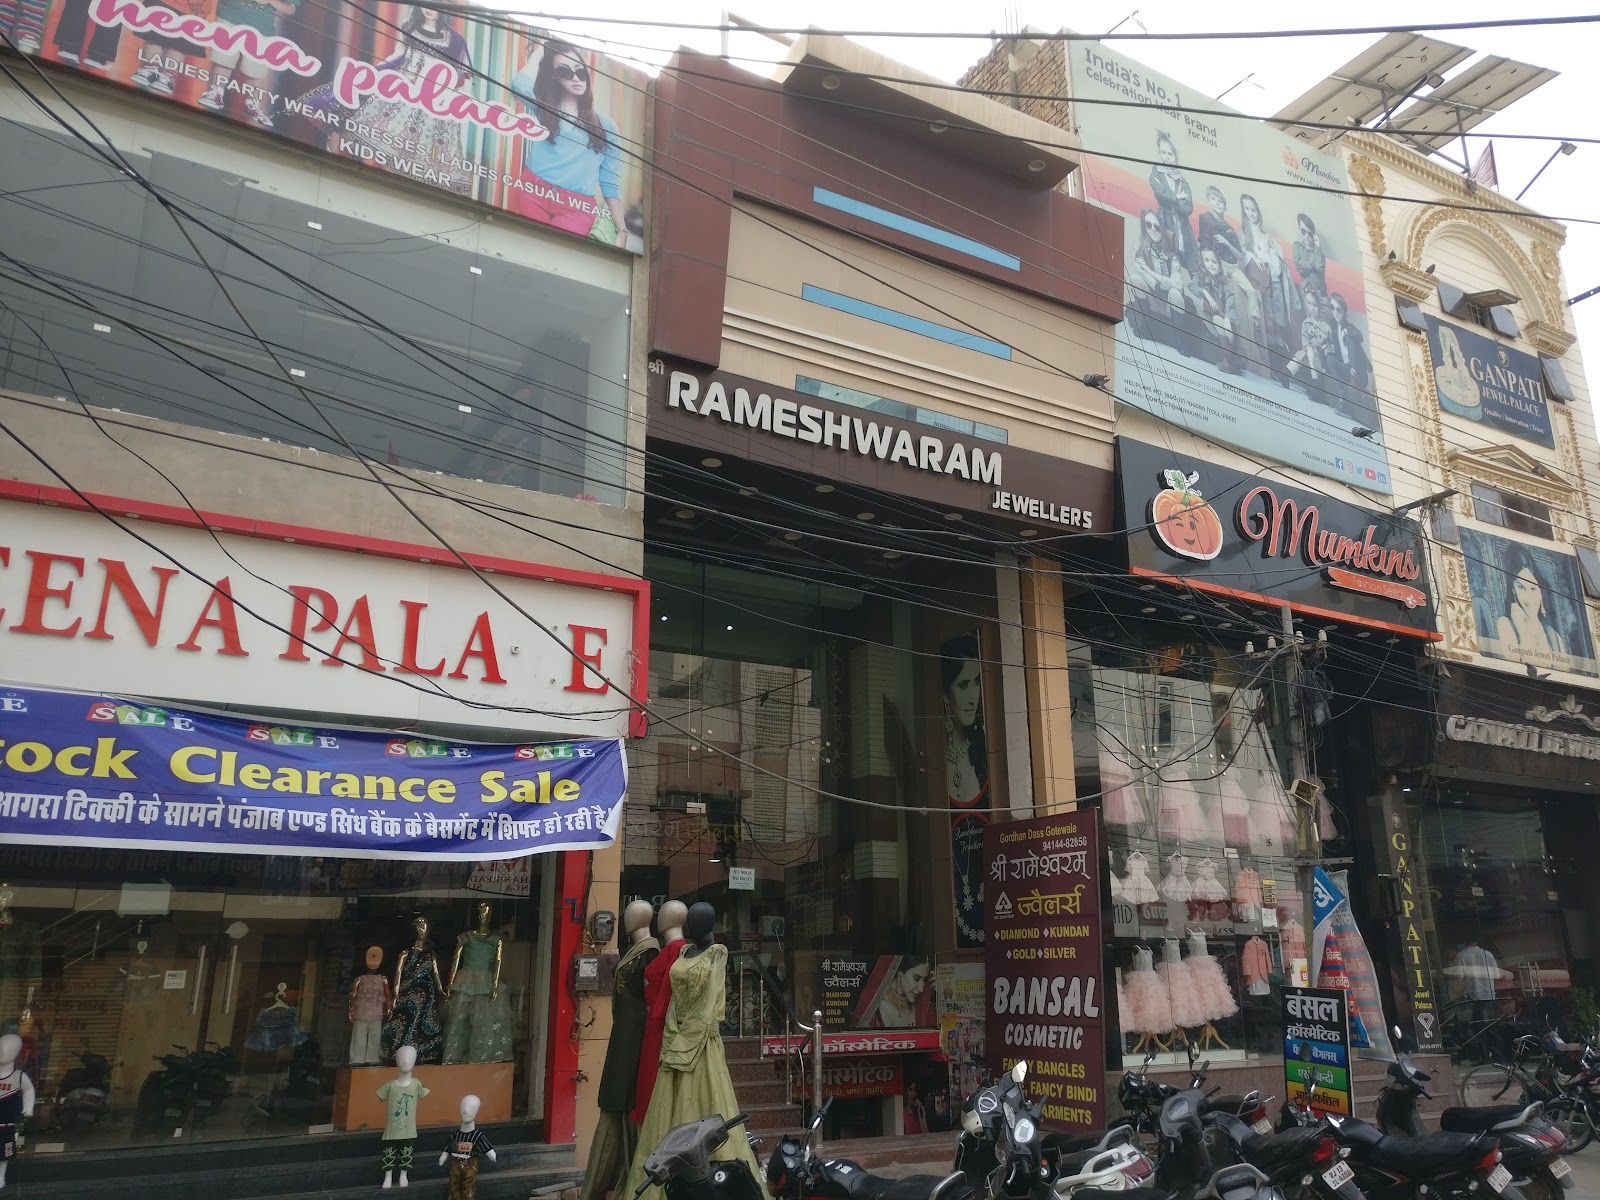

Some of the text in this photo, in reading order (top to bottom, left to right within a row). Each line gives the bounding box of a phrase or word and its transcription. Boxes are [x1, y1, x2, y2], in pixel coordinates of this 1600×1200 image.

[1085, 47, 1142, 87] India's
[1145, 78, 1171, 106] No.
[338, 60, 550, 139] palace
[1086, 66, 1153, 106] Celebration
[1184, 113, 1218, 138] Brand
[137, 48, 613, 220] LADIES PARTY WEAR DRESSES LADIES CASUAL WEAR
[1188, 128, 1219, 148] For Kids
[338, 138, 452, 187] KIDS WEAR
[1470, 356, 1545, 405] GANPATI
[1481, 386, 1541, 418] JEWEL PALACE
[668, 371, 1003, 486] RAMESHWARAM
[1504, 414, 1530, 429] Innovation
[992, 490, 1093, 530] JEWELLERS
[1238, 485, 1420, 581] Mumkins
[0, 546, 250, 657] ENA
[1551, 653, 1571, 665] Palace
[91, 706, 195, 732] SALE
[250, 727, 340, 750] SALE
[388, 740, 473, 758] SALE
[518, 745, 596, 759] SALE
[0, 737, 581, 804] ock Clearance Sale
[137, 793, 160, 825] के
[164, 796, 223, 828] सामने
[228, 797, 284, 831] पंजाब
[330, 807, 368, 836] सिंध
[367, 809, 401, 838] बैंक
[403, 812, 422, 838] के
[480, 811, 500, 841] में
[498, 812, 541, 841] शिफ्ट
[544, 812, 562, 835] हो
[561, 806, 592, 831] रही
[1000, 822, 1078, 844] Gordhan Dass Gotewale
[989, 849, 1091, 882] श्री रामेश्वरम्
[1016, 884, 1086, 916] ज्वैलर्स
[1391, 832, 1425, 988] GANPATI
[1000, 925, 1090, 940] DIAMOND KUNDAN
[821, 960, 868, 975] श्री रामेश्वरम्
[1012, 947, 1077, 960] GOLD SILVER
[825, 991, 851, 999] DIAMOND
[993, 976, 1100, 1018] BANSAL
[1285, 989, 1339, 1023] बंसल
[1414, 990, 1430, 999] Jewel
[1414, 1001, 1433, 1010] Palace
[1004, 1022, 1084, 1050] COSMETIC
[1286, 1022, 1341, 1043] कॉस्मेटिक
[1036, 1060, 1086, 1079] BANGLES
[1030, 1080, 1064, 1099] FANCY
[1066, 1084, 1097, 1103] BINDI
[1037, 1102, 1093, 1125] ARMENTS
